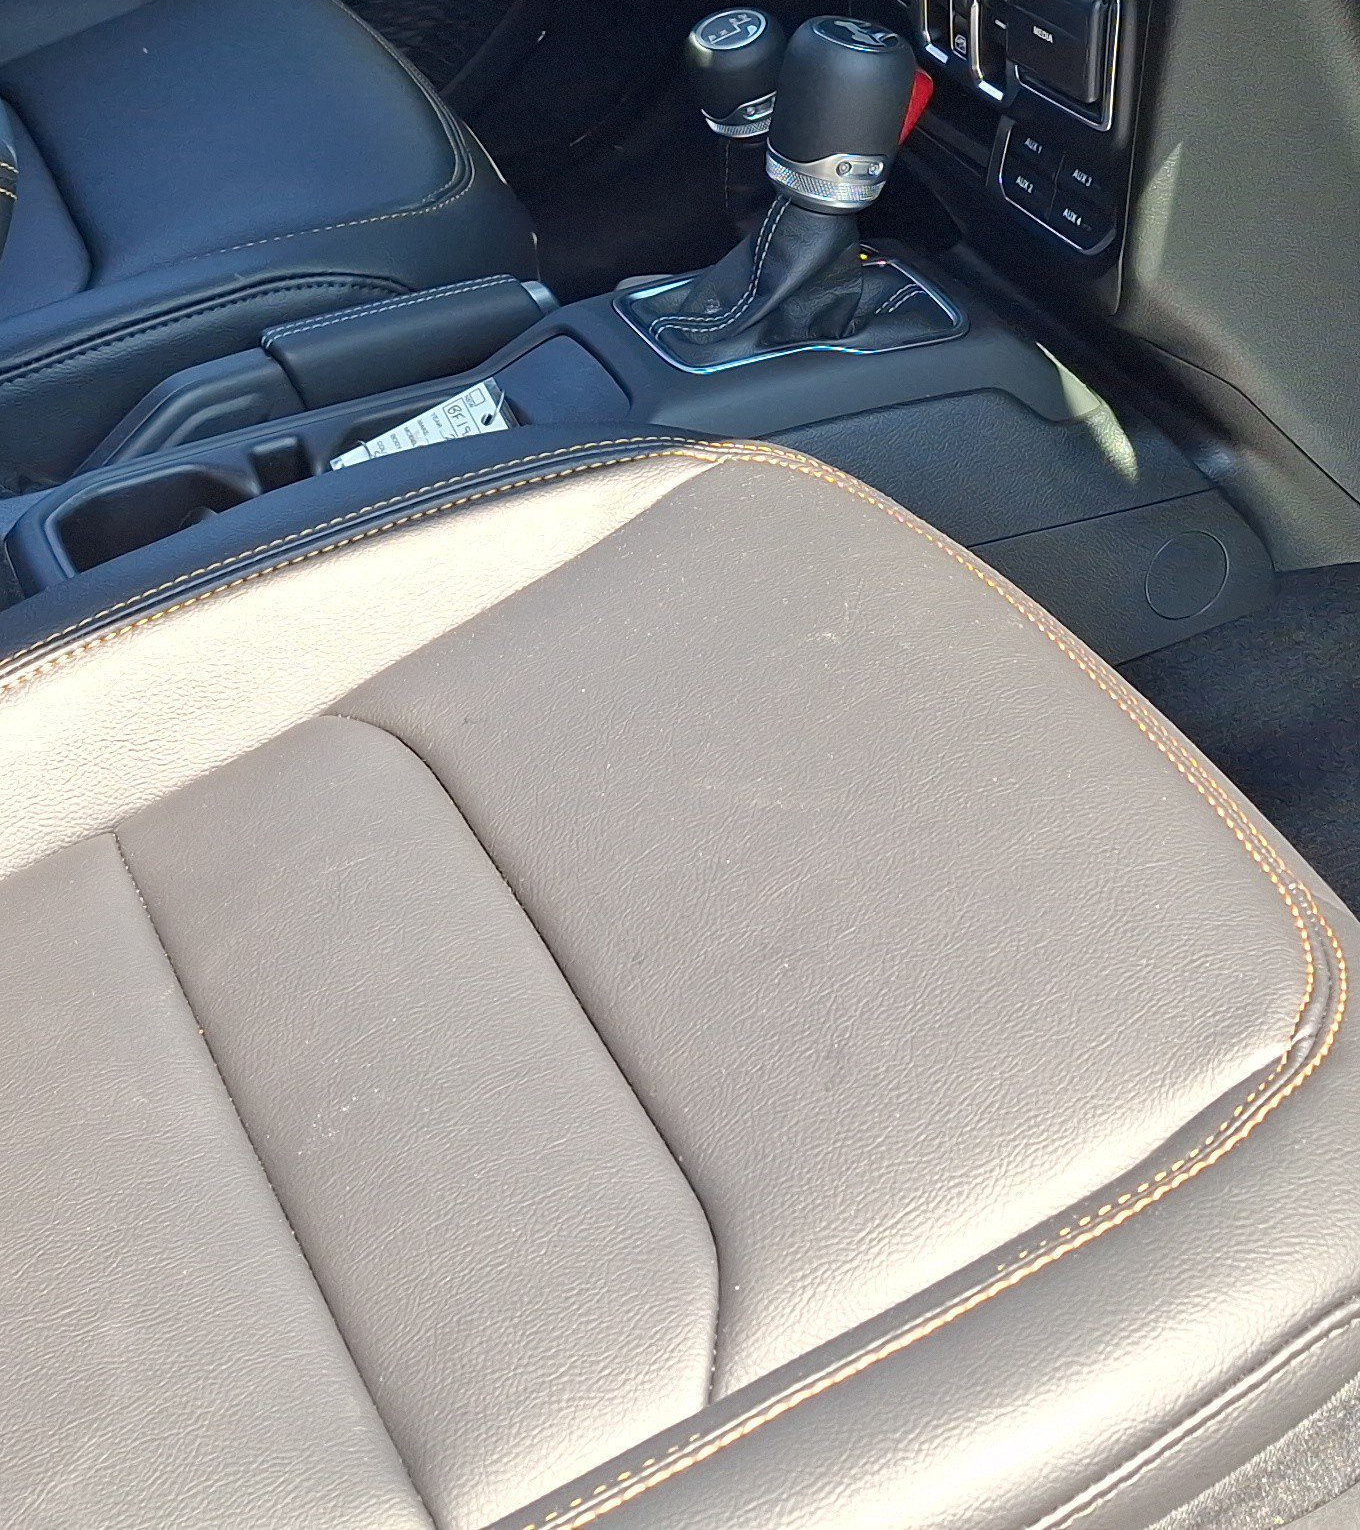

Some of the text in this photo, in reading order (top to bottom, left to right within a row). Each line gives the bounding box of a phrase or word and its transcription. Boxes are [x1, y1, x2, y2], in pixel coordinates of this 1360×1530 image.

[1033, 26, 1053, 44] MEDIA
[1024, 137, 1042, 154] AUX 1
[1016, 175, 1034, 194] AUX 2
[1072, 169, 1092, 186] AUX 3
[1063, 208, 1082, 226] AUX 4
